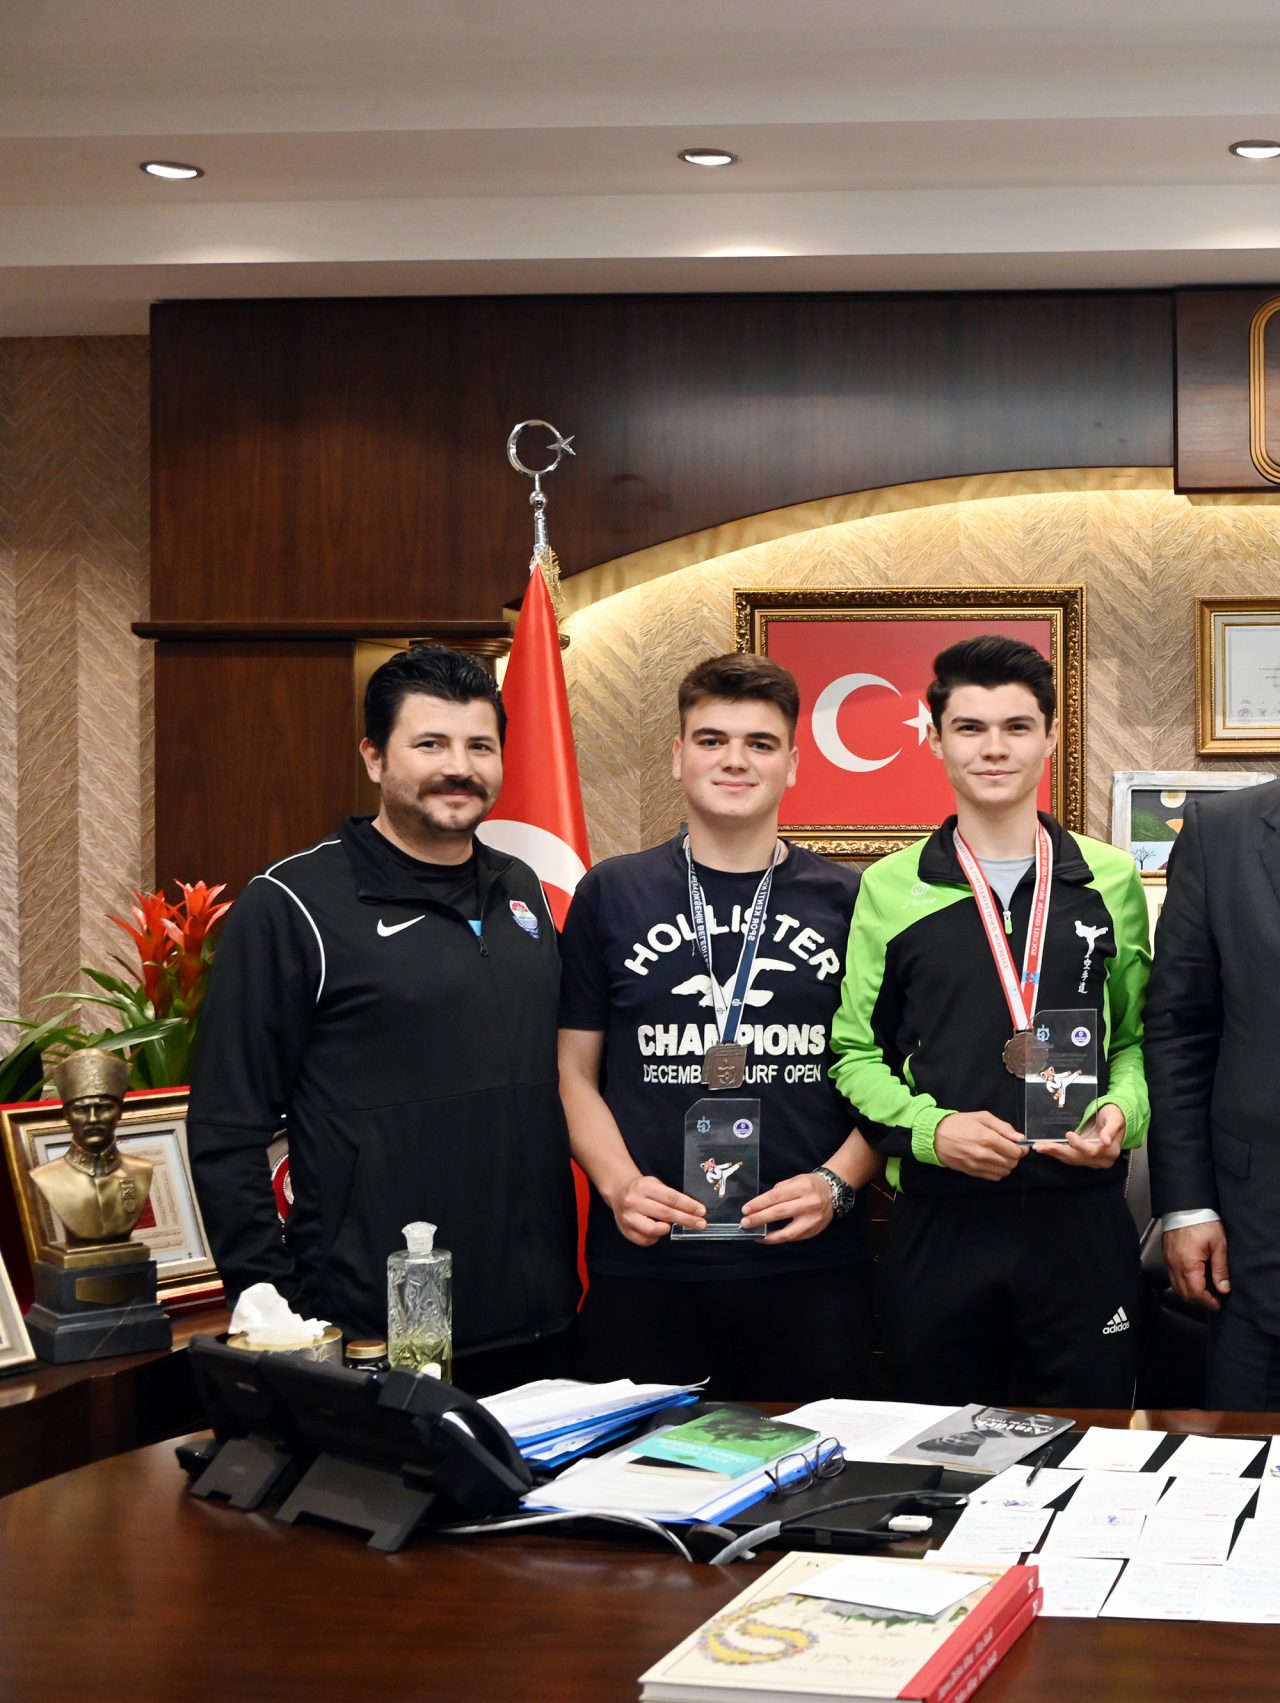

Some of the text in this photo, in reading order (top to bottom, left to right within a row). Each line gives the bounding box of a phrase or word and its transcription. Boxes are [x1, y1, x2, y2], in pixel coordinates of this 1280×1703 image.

[624, 904, 840, 981] HOLLISTER
[643, 1063, 822, 1084] DECEMB URF OPEN
[1102, 1320, 1130, 1335] adidas
